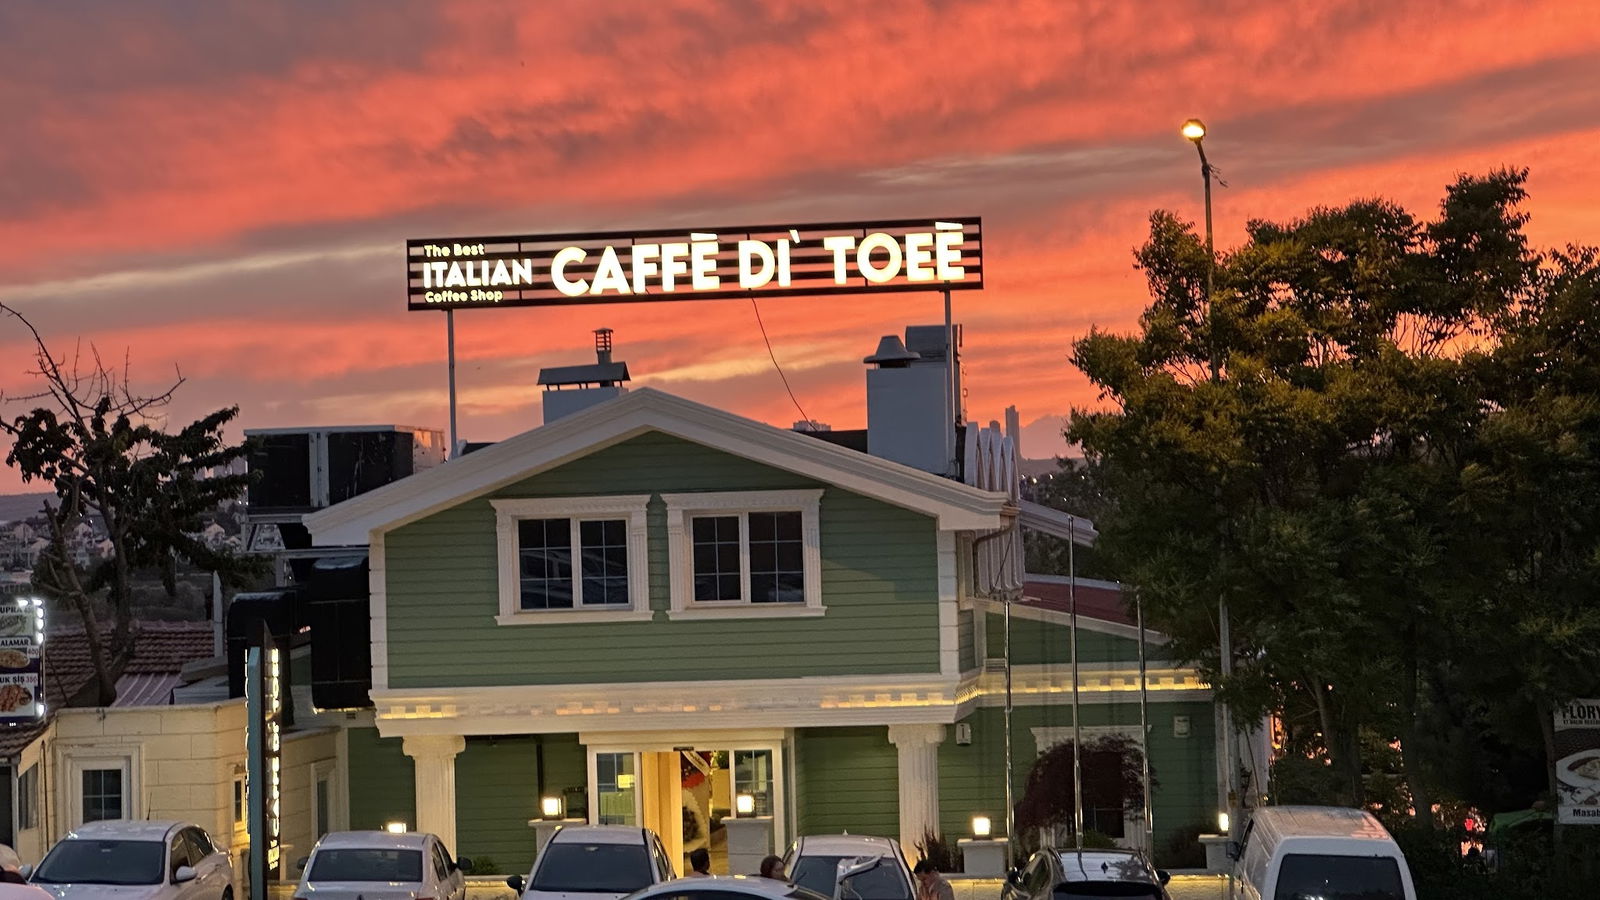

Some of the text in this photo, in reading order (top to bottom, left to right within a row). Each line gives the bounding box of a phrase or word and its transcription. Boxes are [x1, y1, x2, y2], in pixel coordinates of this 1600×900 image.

[424, 243, 485, 257] The Best
[423, 258, 532, 288] ITALIAN
[425, 289, 503, 303] Coffee Shop
